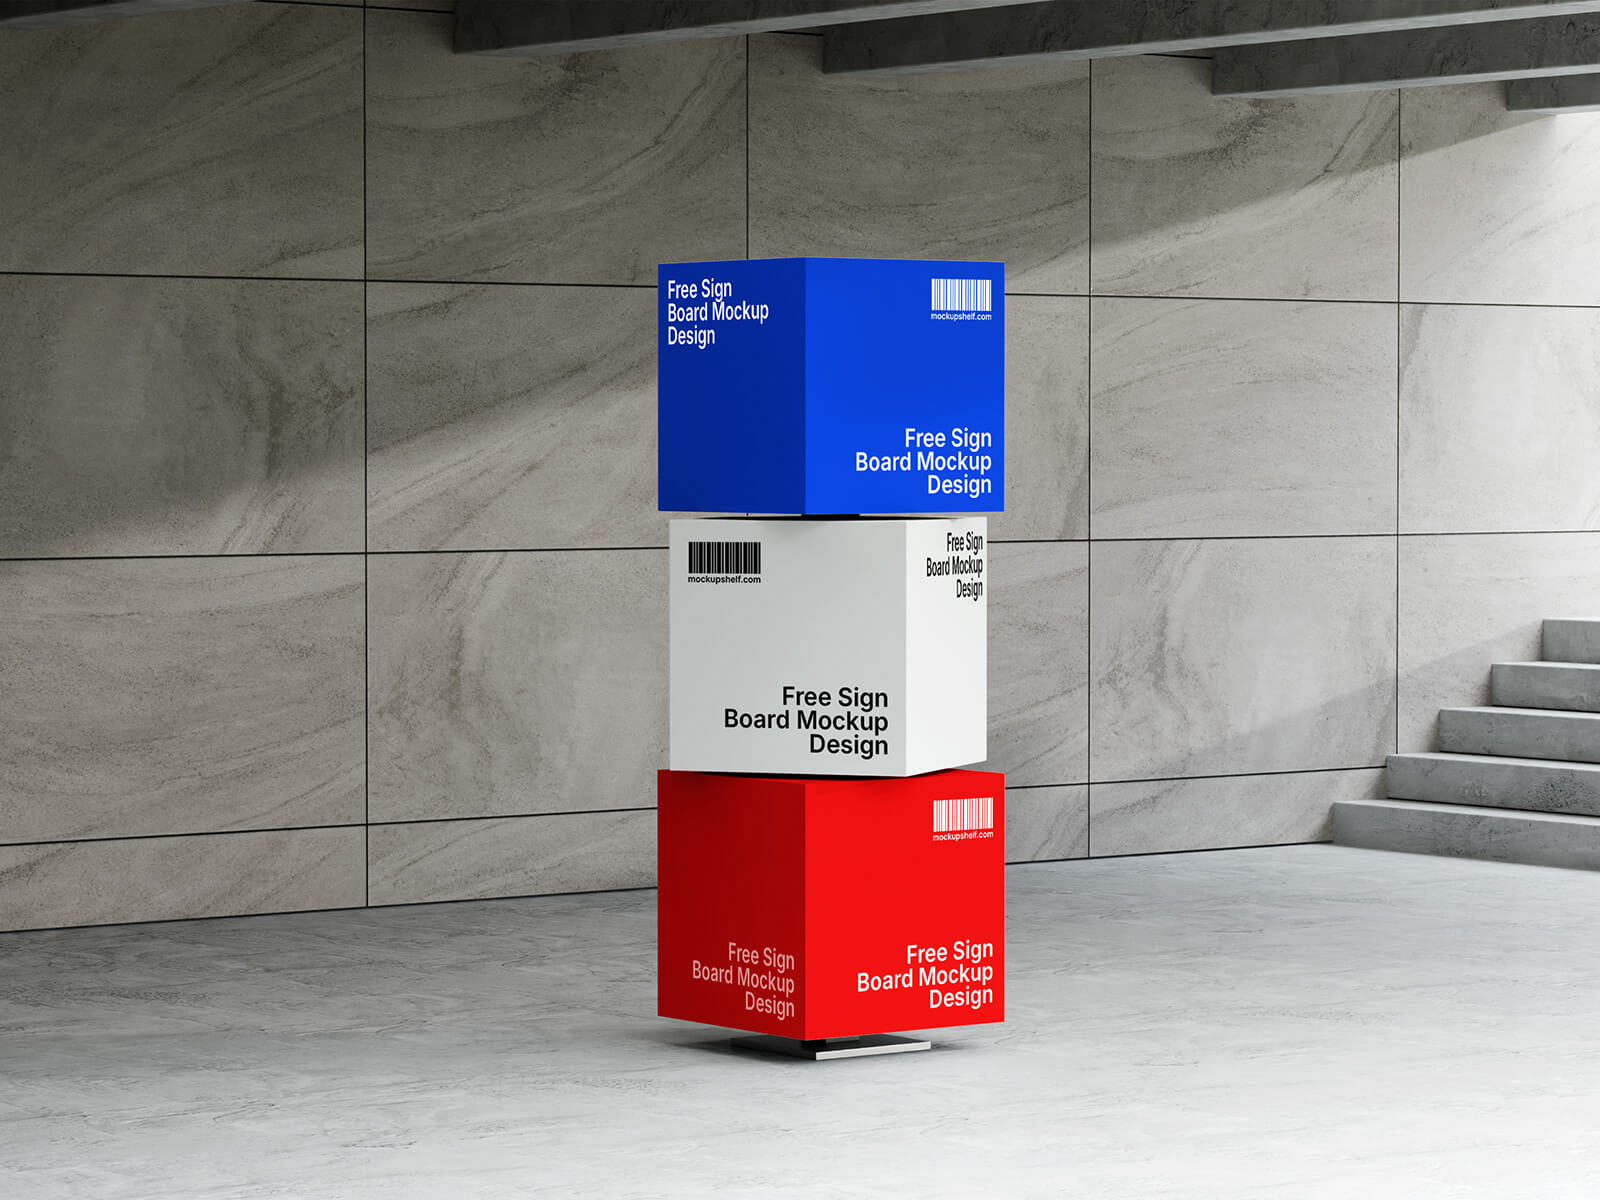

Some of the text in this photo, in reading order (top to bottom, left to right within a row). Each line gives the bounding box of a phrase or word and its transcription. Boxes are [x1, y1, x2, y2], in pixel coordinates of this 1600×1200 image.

[667, 278, 732, 303] Free Sign
[667, 301, 769, 325] Board Mockup
[931, 312, 992, 321] mockupshelf.com
[667, 325, 715, 350] Design
[905, 427, 992, 452] Free Sign
[856, 451, 992, 475] Board Mockup
[927, 474, 992, 498] Design
[946, 531, 983, 555] Free Sign
[926, 556, 983, 578] Board Mockup
[687, 575, 761, 585] mockupshelf.com
[956, 578, 983, 602] Design
[782, 686, 888, 712] Free Sign
[724, 708, 888, 736] Board Mockup
[810, 734, 888, 760] Design
[932, 830, 994, 842] mockupshelf.com
[728, 941, 795, 973] Free Sign
[907, 939, 993, 965] Free Sign
[692, 959, 795, 998] Board Mockup
[857, 963, 993, 992] Board Mockup
[745, 991, 795, 1021] Design
[929, 985, 993, 1010] Design
